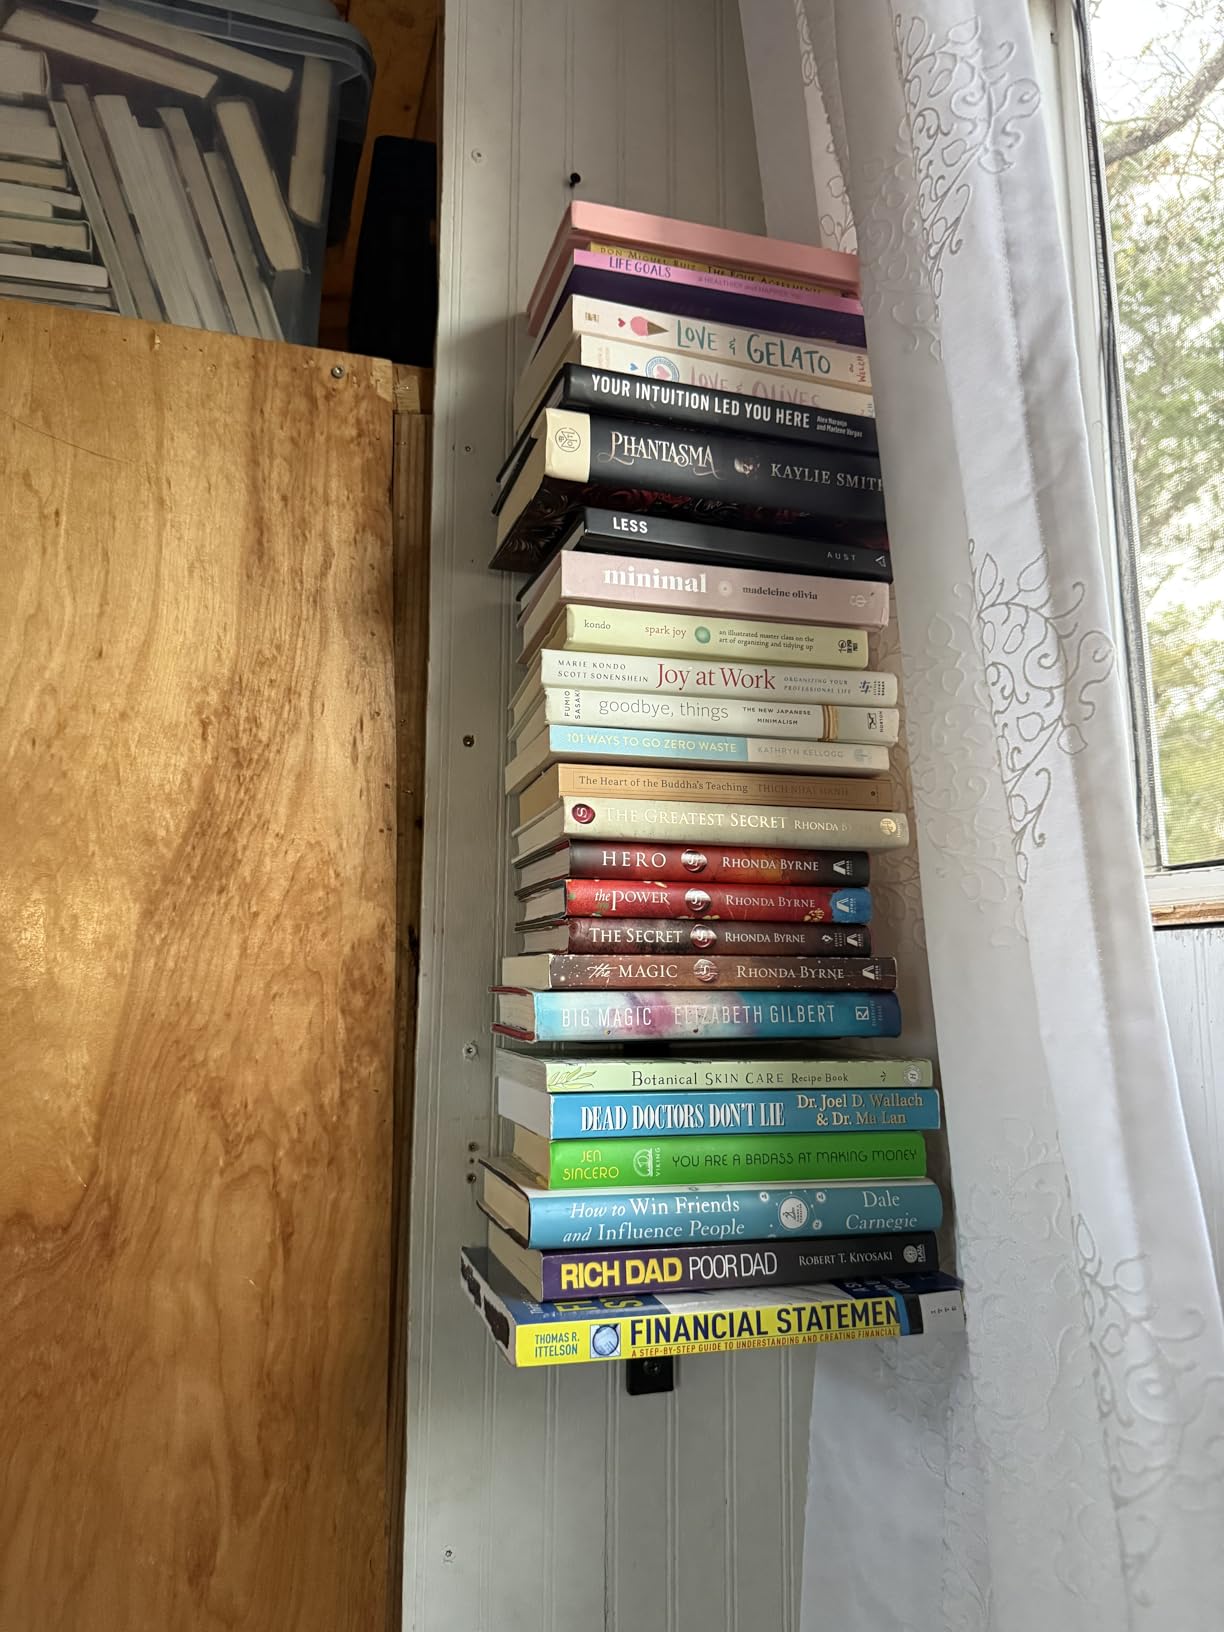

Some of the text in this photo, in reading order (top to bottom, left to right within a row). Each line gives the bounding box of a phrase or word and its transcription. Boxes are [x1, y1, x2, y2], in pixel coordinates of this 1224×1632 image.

[609, 256, 672, 278] LIFE GOALS
[677, 319, 831, 374] LOVE & GELATO
[592, 374, 810, 429] YOUR INTUITION LED YOU HERE
[598, 431, 725, 479] PHANTASMA
[770, 463, 831, 484] KAYLIE
[612, 516, 649, 534] LESS
[826, 551, 857, 561] AUST
[602, 565, 818, 600] minimal madeleine olivia
[584, 619, 687, 639] kondo spark joy
[727, 629, 759, 639] illustrated
[759, 632, 779, 640] master
[780, 633, 795, 641] class
[804, 635, 815, 643] the
[737, 639, 770, 649] organizing
[770, 640, 782, 648] and
[782, 641, 804, 651] tidying
[805, 644, 814, 652] up
[558, 659, 627, 670] MARIE KONDO
[558, 671, 649, 683] SCOTT SONENSHEIN
[655, 663, 776, 691] Joy at Work
[783, 675, 849, 686] ORGANIZING YOUR
[837, 687, 851, 695] LIFE
[599, 699, 729, 721] goodbye, things
[776, 708, 812, 716] JAPANESE
[756, 717, 798, 726] MINIMALISM
[567, 733, 737, 753] 101 WAYS TO GO ZERO WASTE
[757, 746, 844, 759] KATHRYN KELLOGG
[579, 775, 748, 793] The Heart of the Buddha's Teaching
[607, 806, 642, 822] THE
[643, 808, 725, 826] GREATEST
[730, 812, 789, 829] SECRET
[794, 820, 839, 832] RHONDA
[602, 850, 819, 871] HERO RHONDA BYRNE
[594, 888, 671, 911] the POWER
[725, 894, 816, 908] RHONDA BYRNE
[588, 927, 806, 944] THE SECRET RHONDA BYRNE
[587, 962, 845, 980] the MAGIC RHONDA BYRNE
[561, 1004, 835, 1028] BIG MAGIC ELIZABETH GILBERT
[631, 1071, 849, 1087] Botanical SKIN CARE Recipe Book
[797, 1092, 924, 1111] Dr. Joel D. Wallach
[580, 1102, 785, 1132] DEAD DOCTORS DON'T LIE
[815, 1111, 906, 1126] & Dr. Ma Lan
[580, 1150, 602, 1163] JEN
[672, 1149, 918, 1168] YOU ARE A BADASS AT MAKING MONEY
[562, 1166, 620, 1181] SINCERO
[569, 1194, 740, 1219] How to Win Friends
[862, 1190, 900, 1208] Dale
[562, 1218, 745, 1243] and Influence People
[845, 1212, 918, 1231] Carnegie
[798, 1250, 893, 1266] ROBERT T. KIYOSAKI
[561, 1251, 778, 1290] RICH DAD POOR DAD
[630, 1310, 769, 1346] FINANCIAL
[535, 1332, 580, 1345] THOMAS R.
[631, 1328, 897, 1358] A STEP-BY-STEP GUIDE TO UNDERSTANDING AND CREATING FINANCIAL
[535, 1344, 578, 1359] ITTELSON
